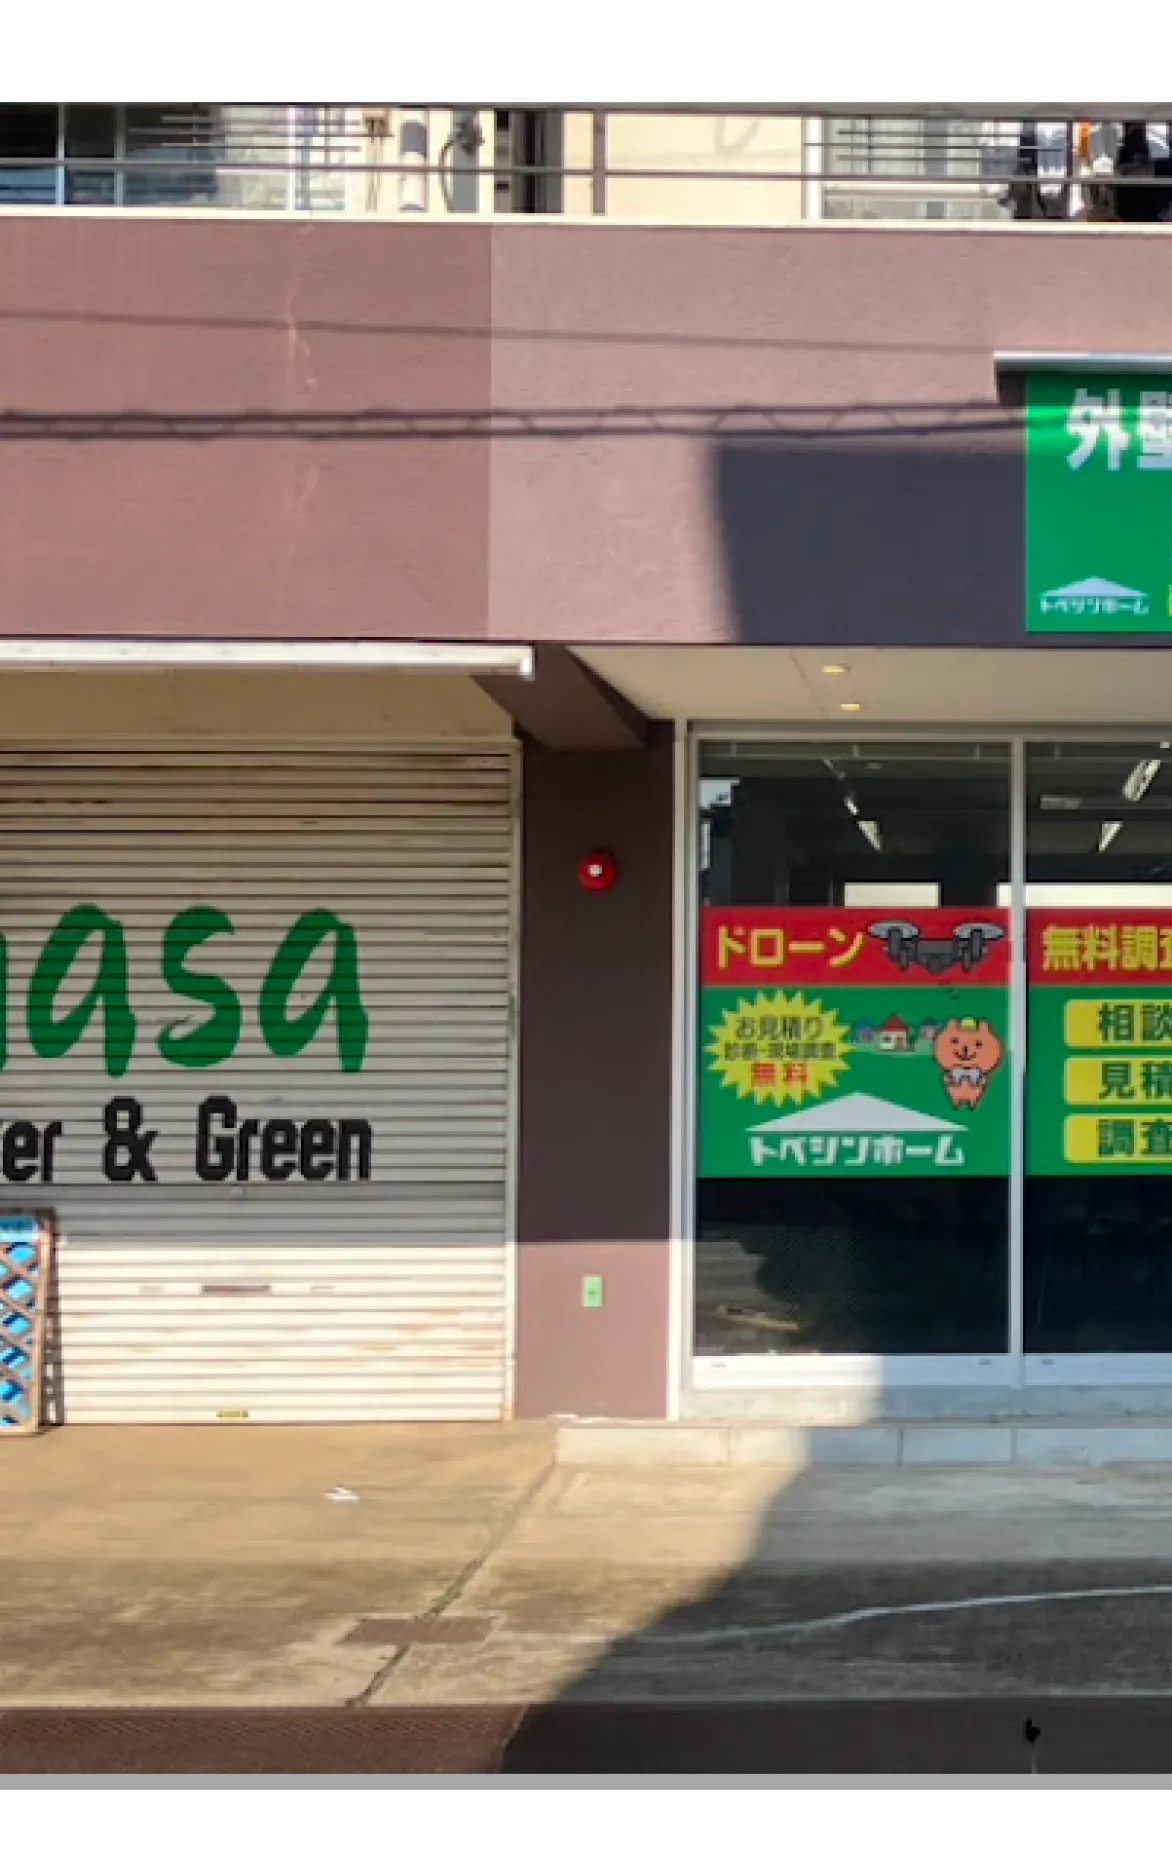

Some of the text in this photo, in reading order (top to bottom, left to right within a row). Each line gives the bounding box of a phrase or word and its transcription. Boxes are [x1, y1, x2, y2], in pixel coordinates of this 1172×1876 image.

[717, 926, 864, 968] ドローン
[0, 903, 368, 1078] asa
[736, 1016, 823, 1041] お見積り
[752, 1063, 809, 1088] 無料
[0, 1096, 373, 1182] er & Green
[750, 1135, 966, 1167] トベシンホーム
